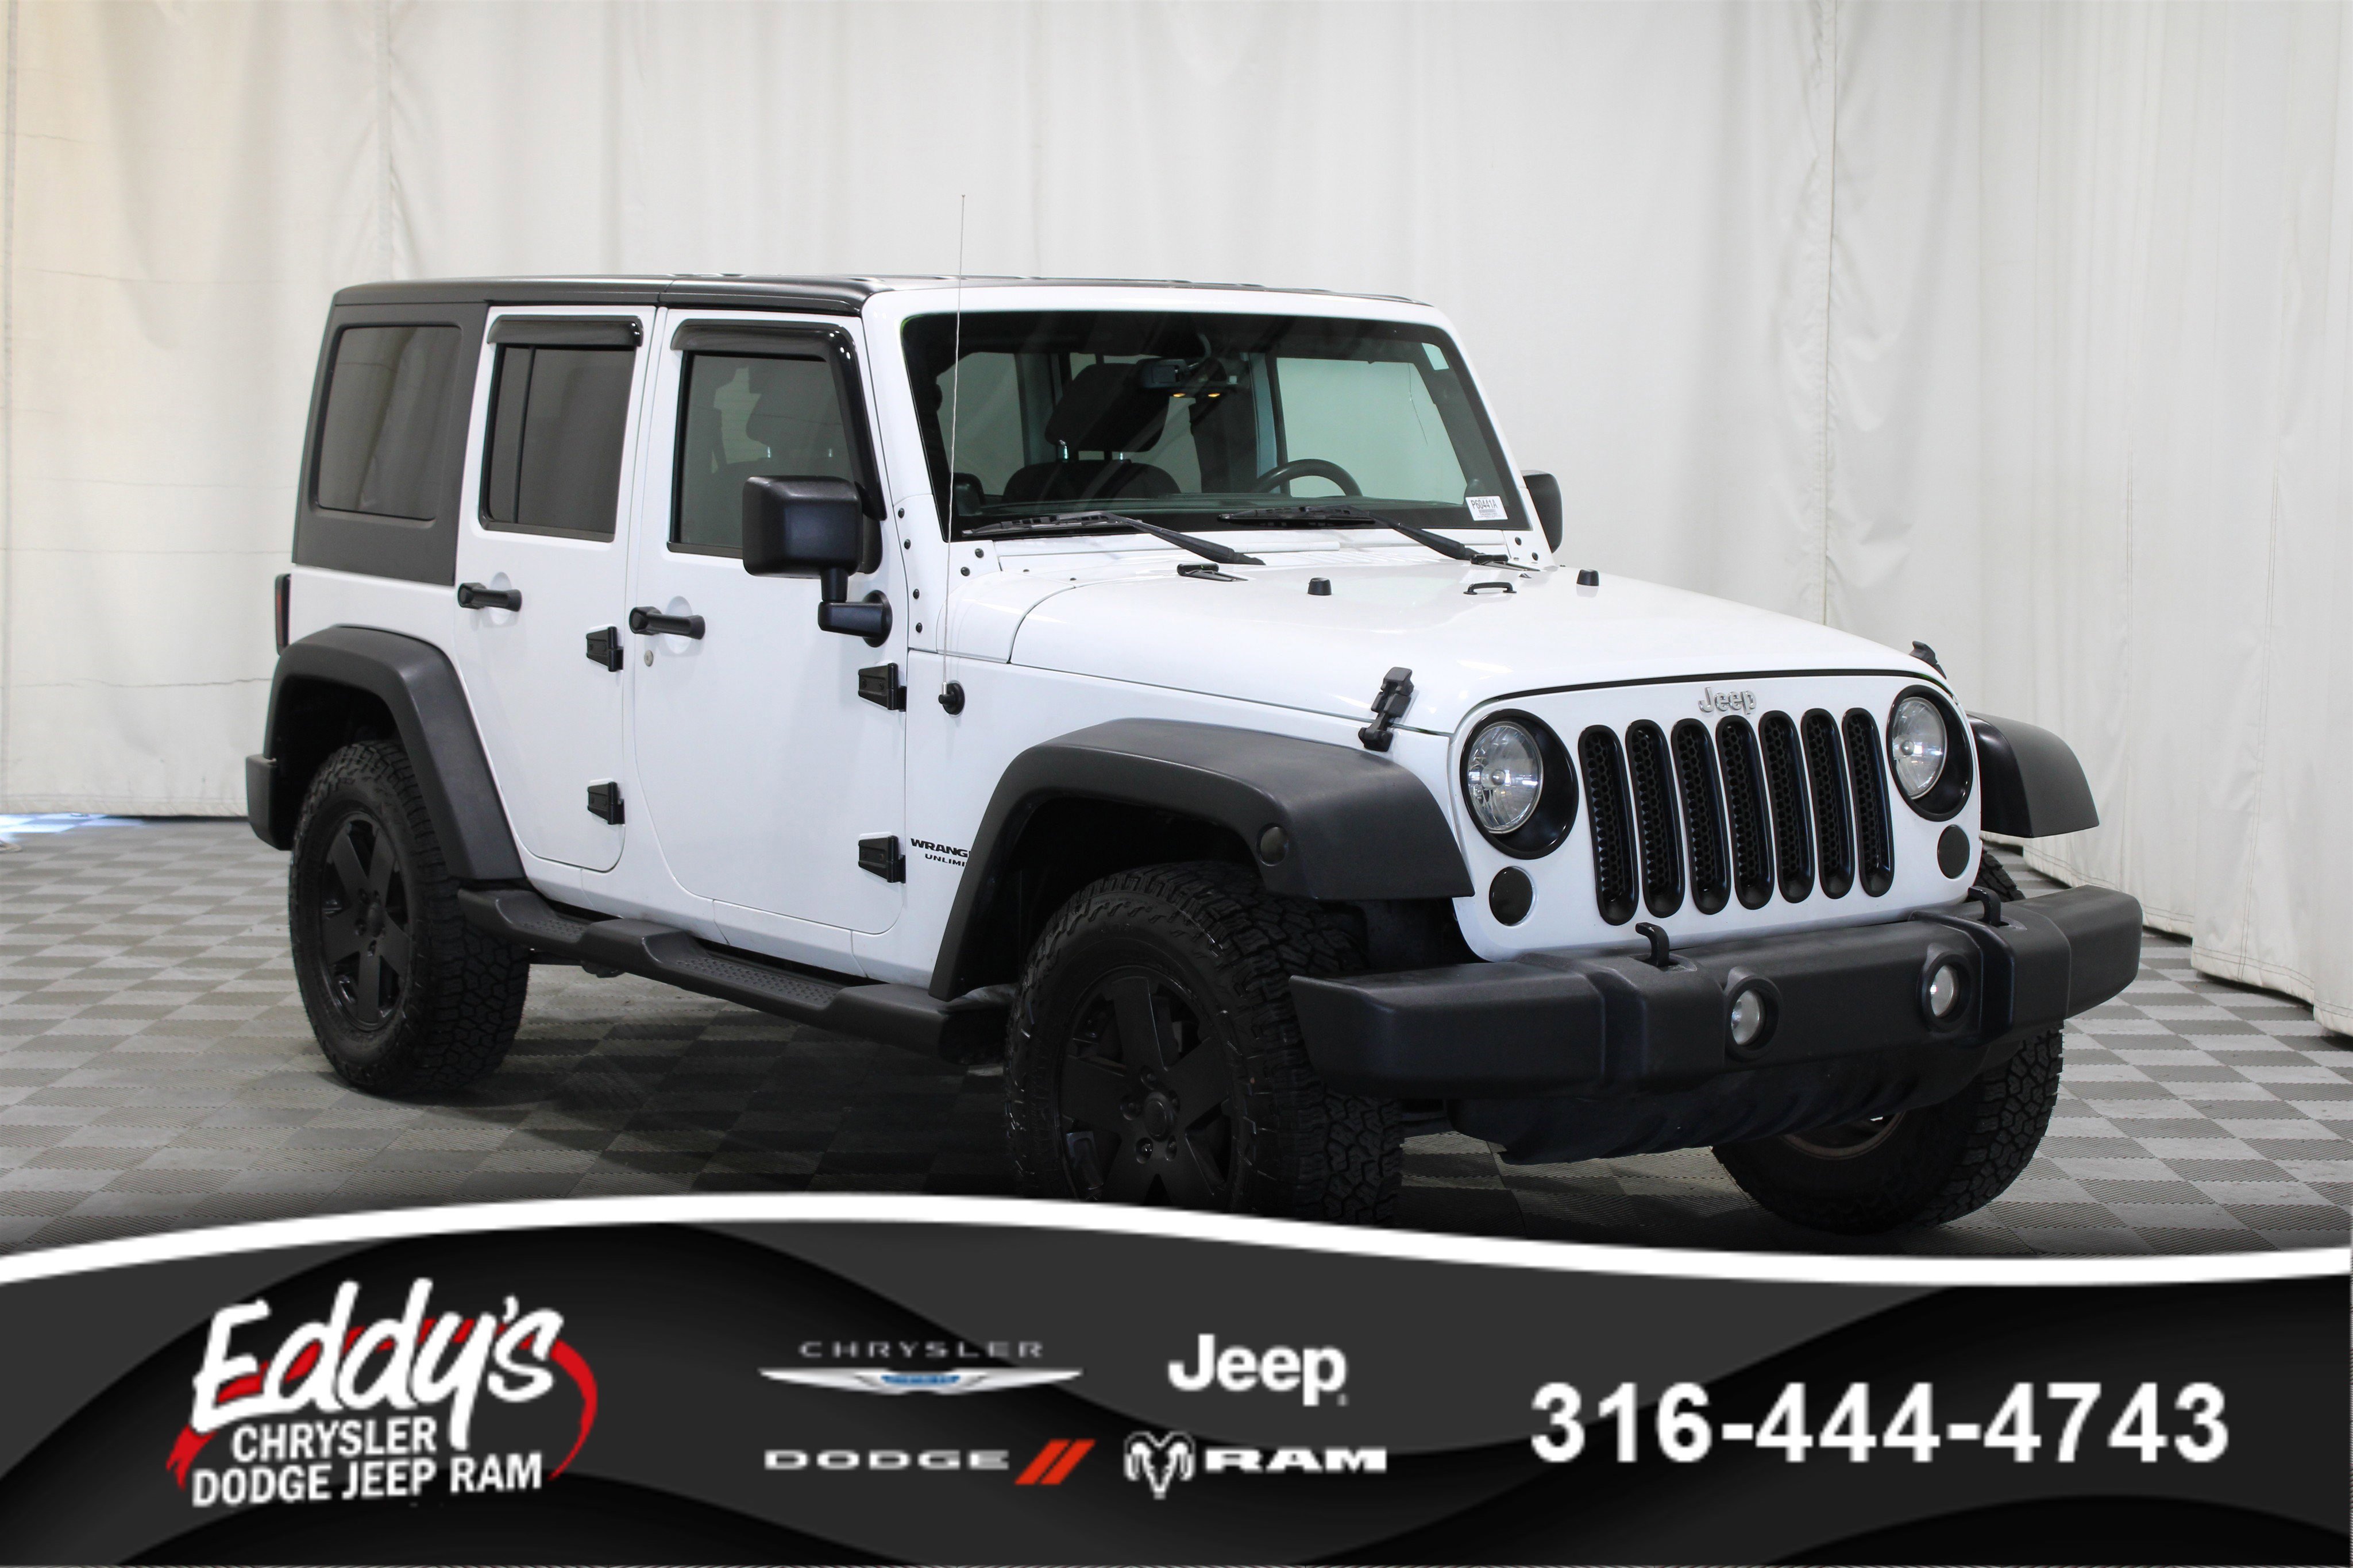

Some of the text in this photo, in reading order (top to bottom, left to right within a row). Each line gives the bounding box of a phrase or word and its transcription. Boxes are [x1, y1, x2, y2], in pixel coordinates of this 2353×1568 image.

[1470, 499, 1498, 509] P60441A
[1698, 686, 1757, 715] Jeep
[910, 837, 971, 858] WRANG
[924, 853, 967, 867] UNLIMI
